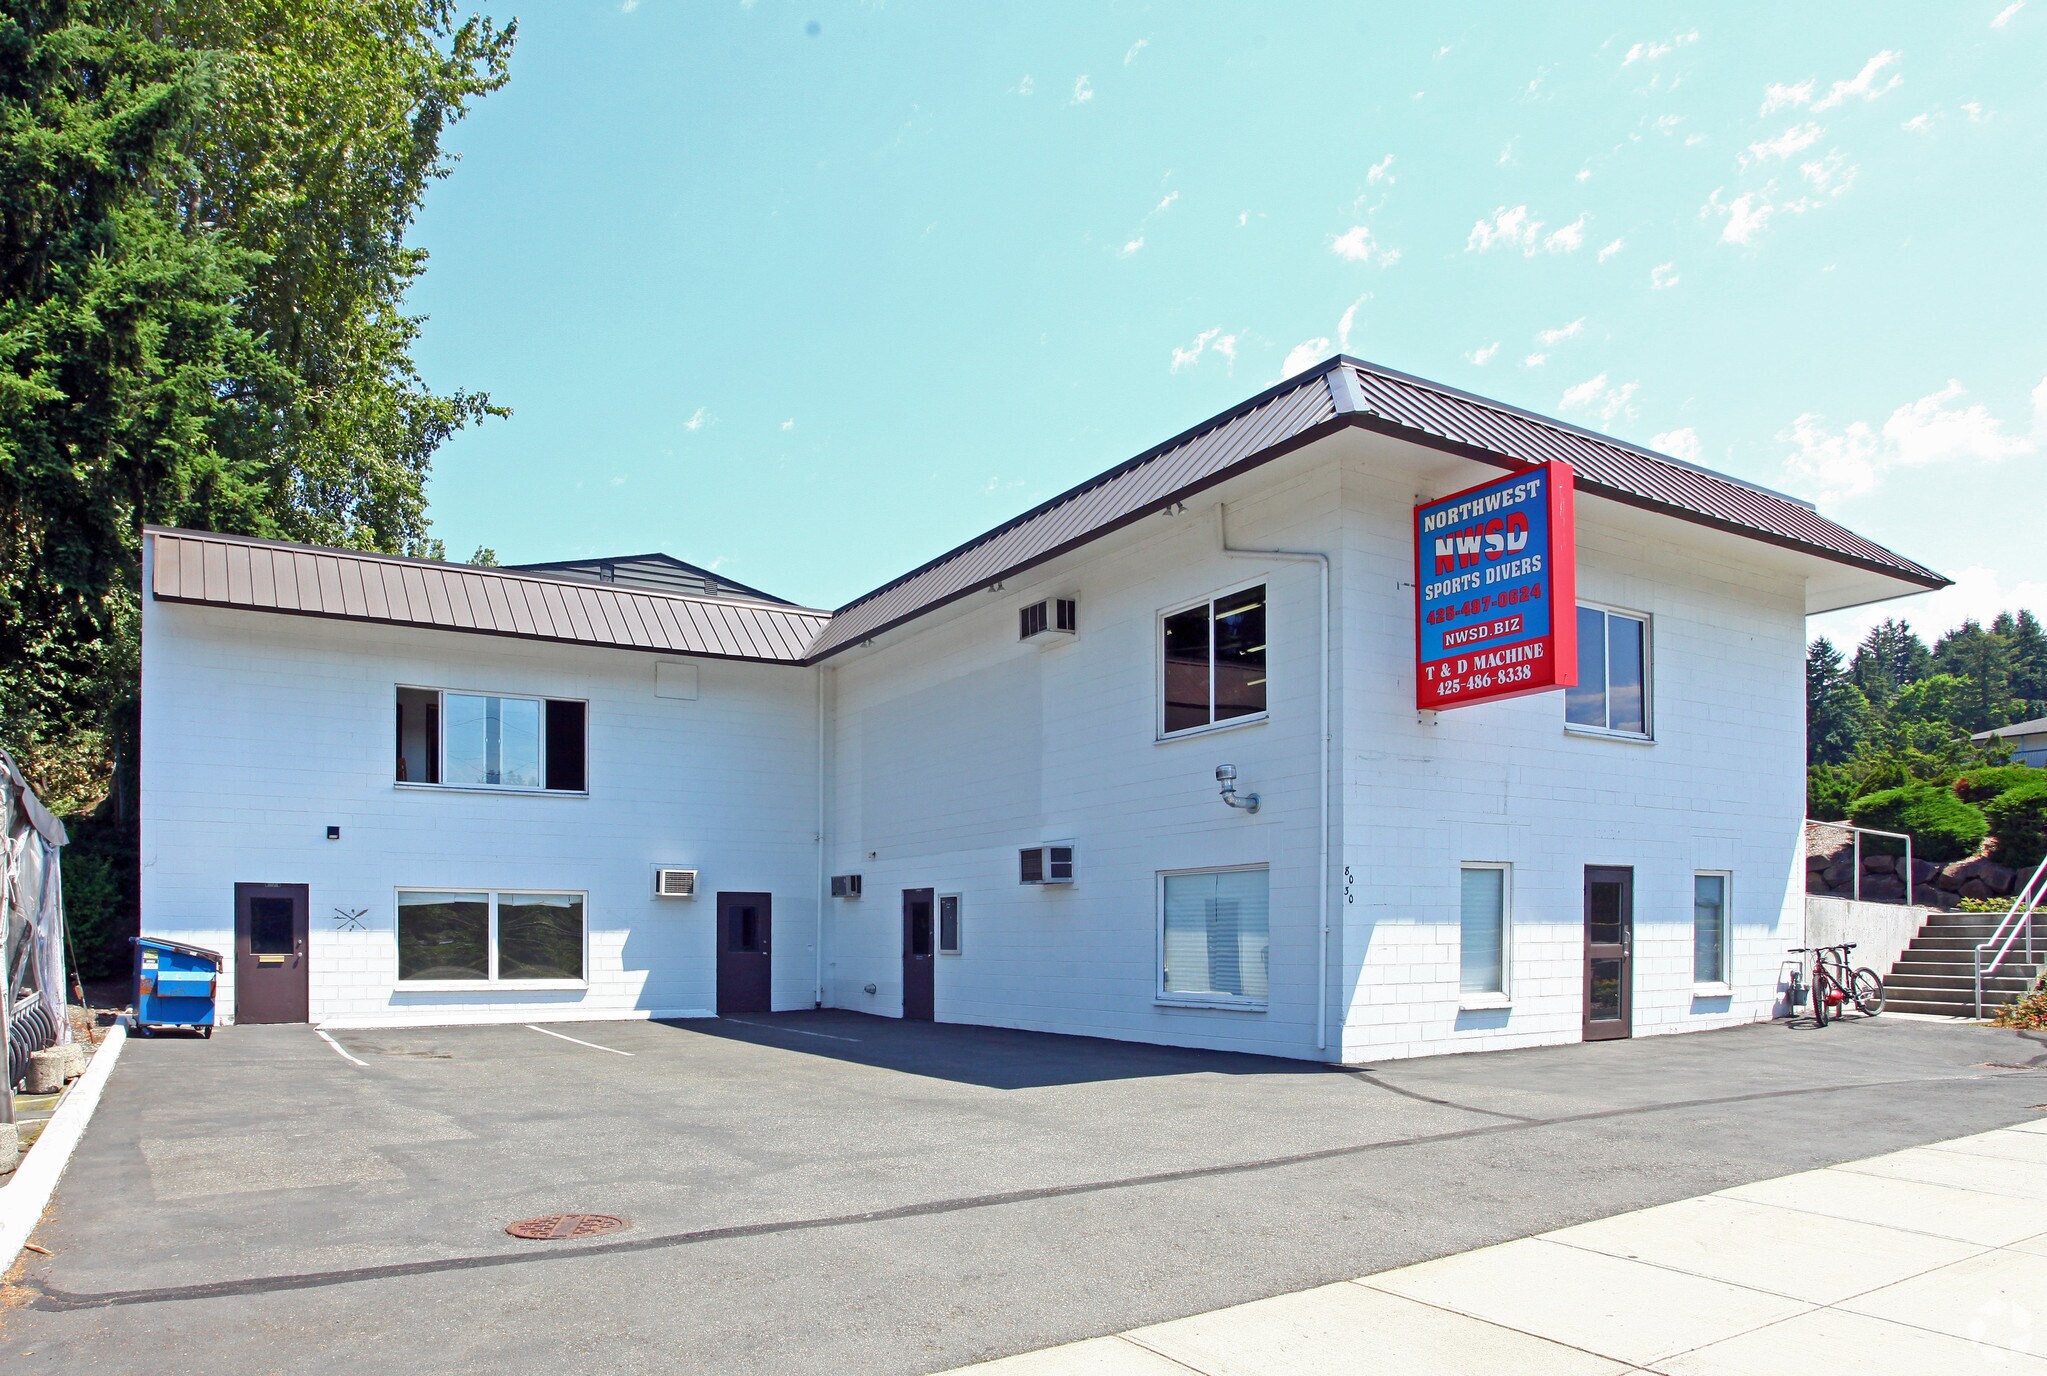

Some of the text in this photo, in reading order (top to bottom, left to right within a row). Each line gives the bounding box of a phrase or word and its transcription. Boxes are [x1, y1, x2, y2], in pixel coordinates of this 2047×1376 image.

[1424, 479, 1541, 533] NORTHWEST
[1435, 511, 1529, 576] NWSD
[1425, 554, 1542, 601] SPORTS DIVERS
[1426, 582, 1542, 625] 425-487-0624
[1445, 617, 1520, 646] NWSD.BIZ
[1425, 642, 1544, 680] T & D MACHINE
[1436, 664, 1532, 696] 425-486-8338
[1343, 865, 1354, 904] 8030
